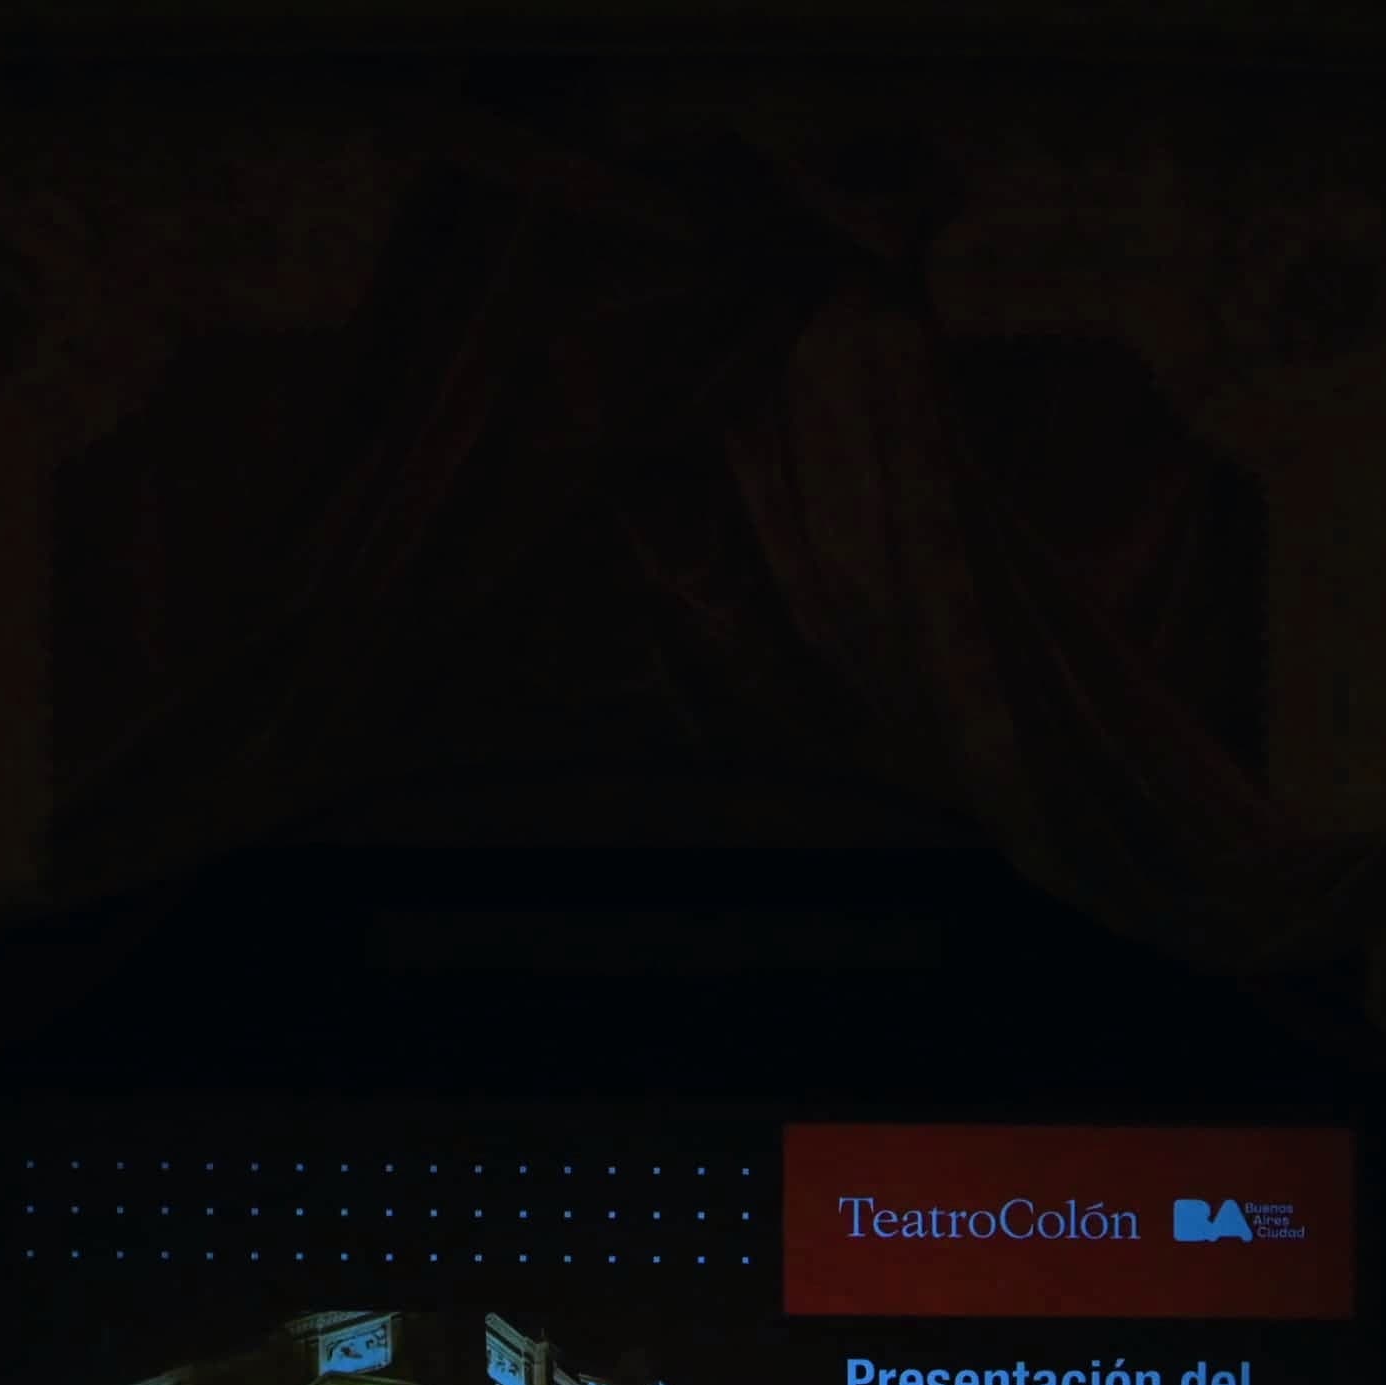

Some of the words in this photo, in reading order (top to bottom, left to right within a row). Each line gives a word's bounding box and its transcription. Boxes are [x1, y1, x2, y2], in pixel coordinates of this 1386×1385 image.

[1245, 1202, 1294, 1214] Buenos
[838, 1196, 1141, 1240] TeatroColón
[1173, 1198, 1254, 1242] BA
[1253, 1214, 1290, 1226] Aires
[1256, 1226, 1305, 1239] Ciudad
